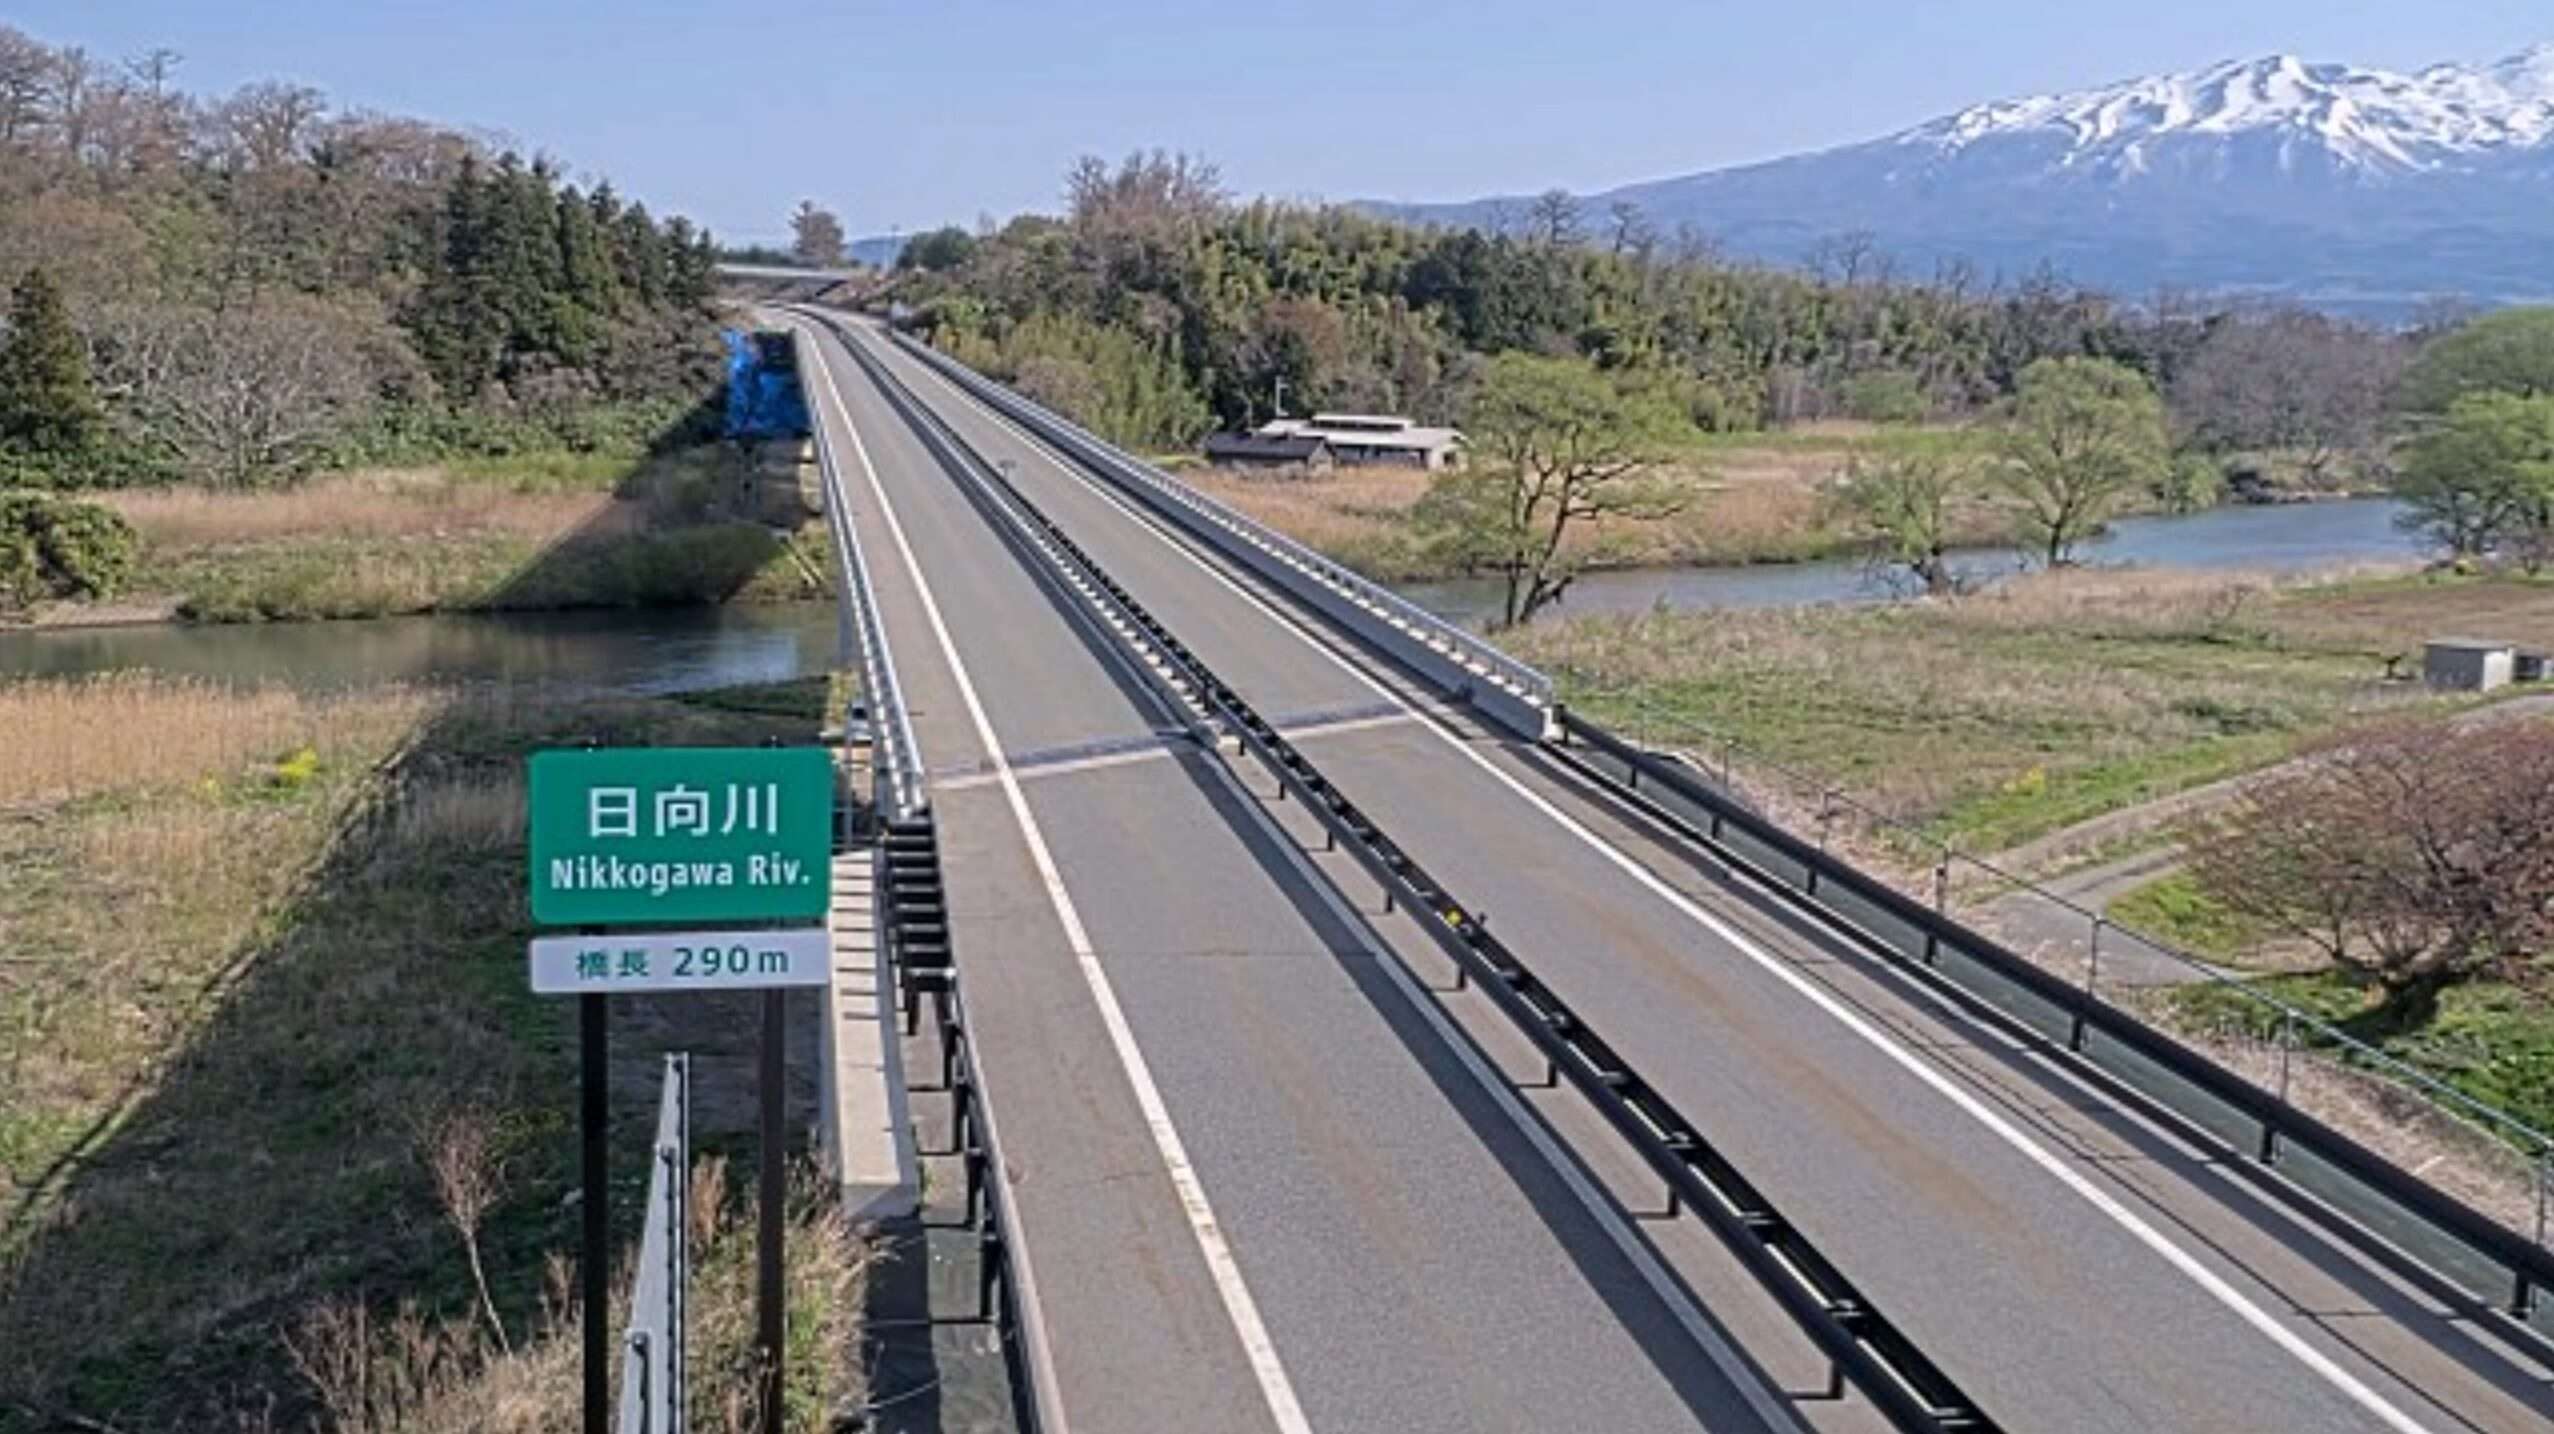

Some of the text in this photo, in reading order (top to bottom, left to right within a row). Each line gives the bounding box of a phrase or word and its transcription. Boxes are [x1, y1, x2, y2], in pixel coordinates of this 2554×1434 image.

[589, 783, 779, 837] 日向川
[551, 852, 810, 896] Nikkogawa Riv.
[672, 944, 789, 977] 290m
